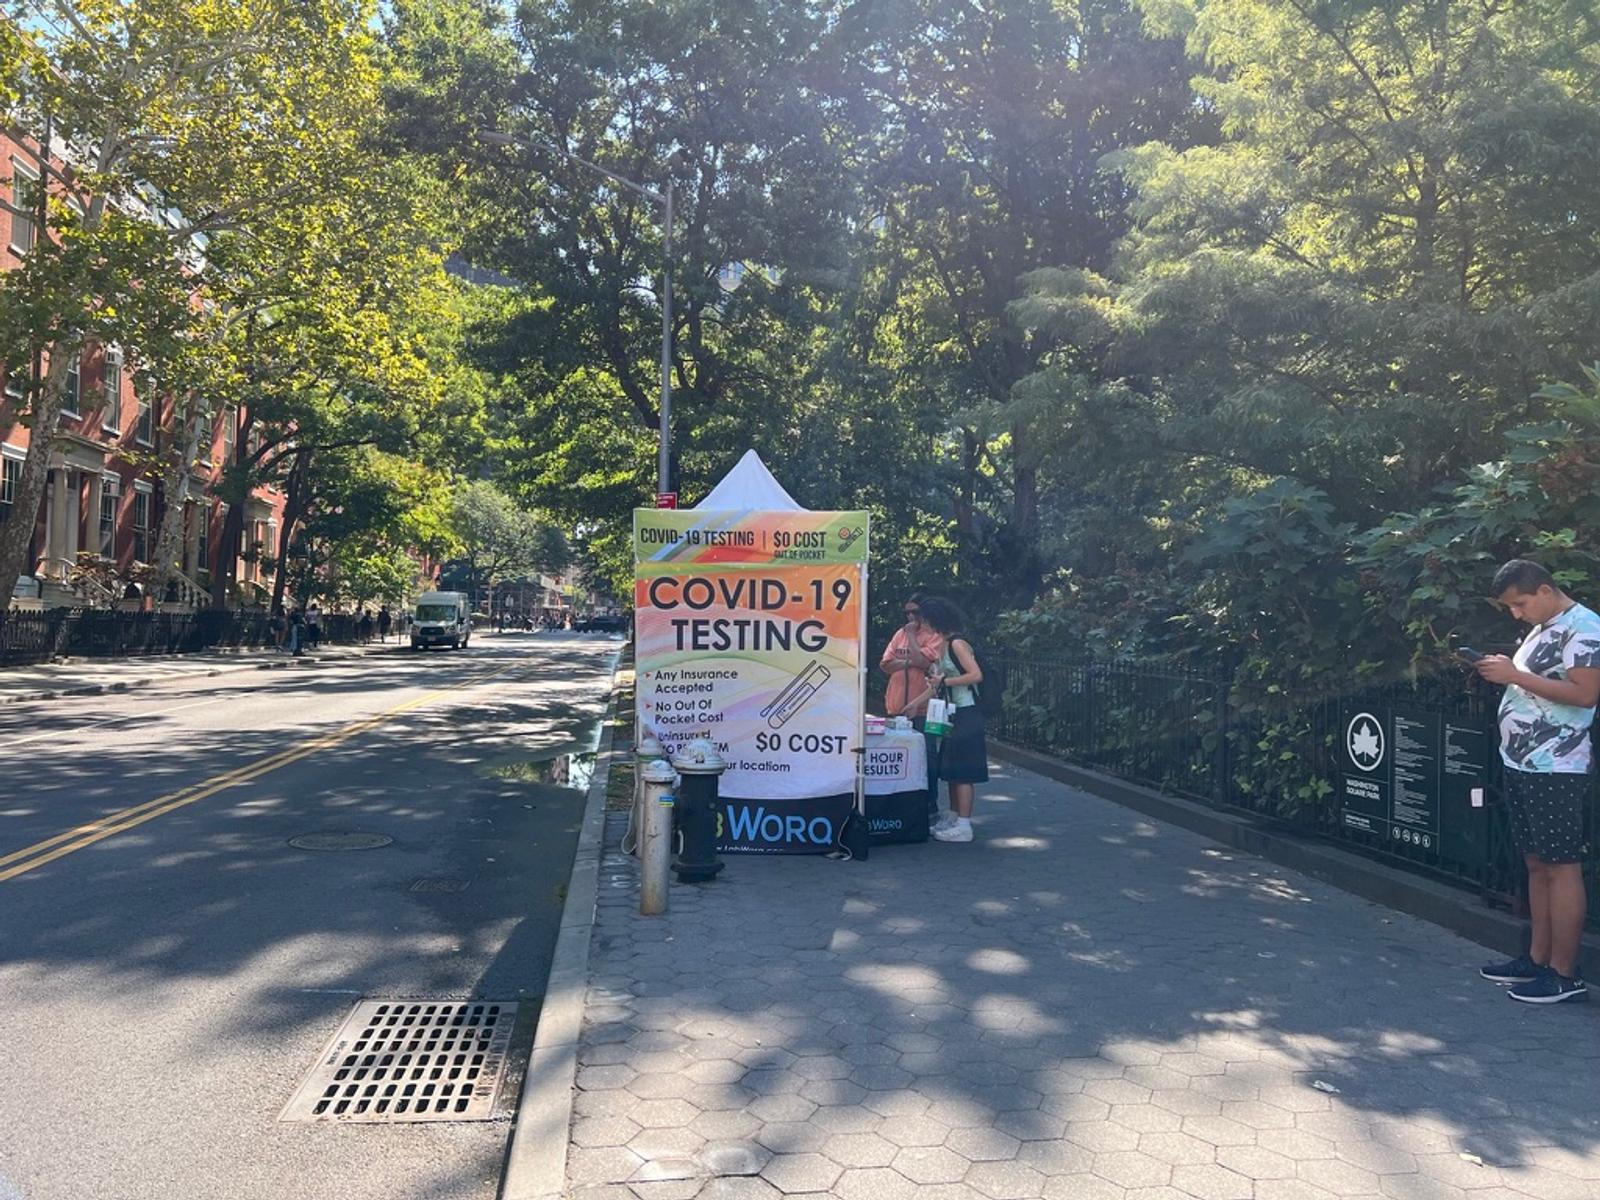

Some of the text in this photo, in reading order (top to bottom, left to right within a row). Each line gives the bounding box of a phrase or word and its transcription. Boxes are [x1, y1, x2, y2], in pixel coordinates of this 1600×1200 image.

[640, 527, 827, 549] COVID-19 TESTING $0 COST
[649, 576, 852, 611] COVID-19
[671, 619, 828, 653] TESTING
[655, 669, 738, 682] Any Insurance
[655, 682, 714, 695] Accepted
[656, 698, 712, 712] No Out Of
[655, 712, 724, 725] Pocket Cost
[755, 731, 848, 755] $0 COST
[870, 752, 903, 763] HOUR
[864, 764, 900, 776] ESULTS
